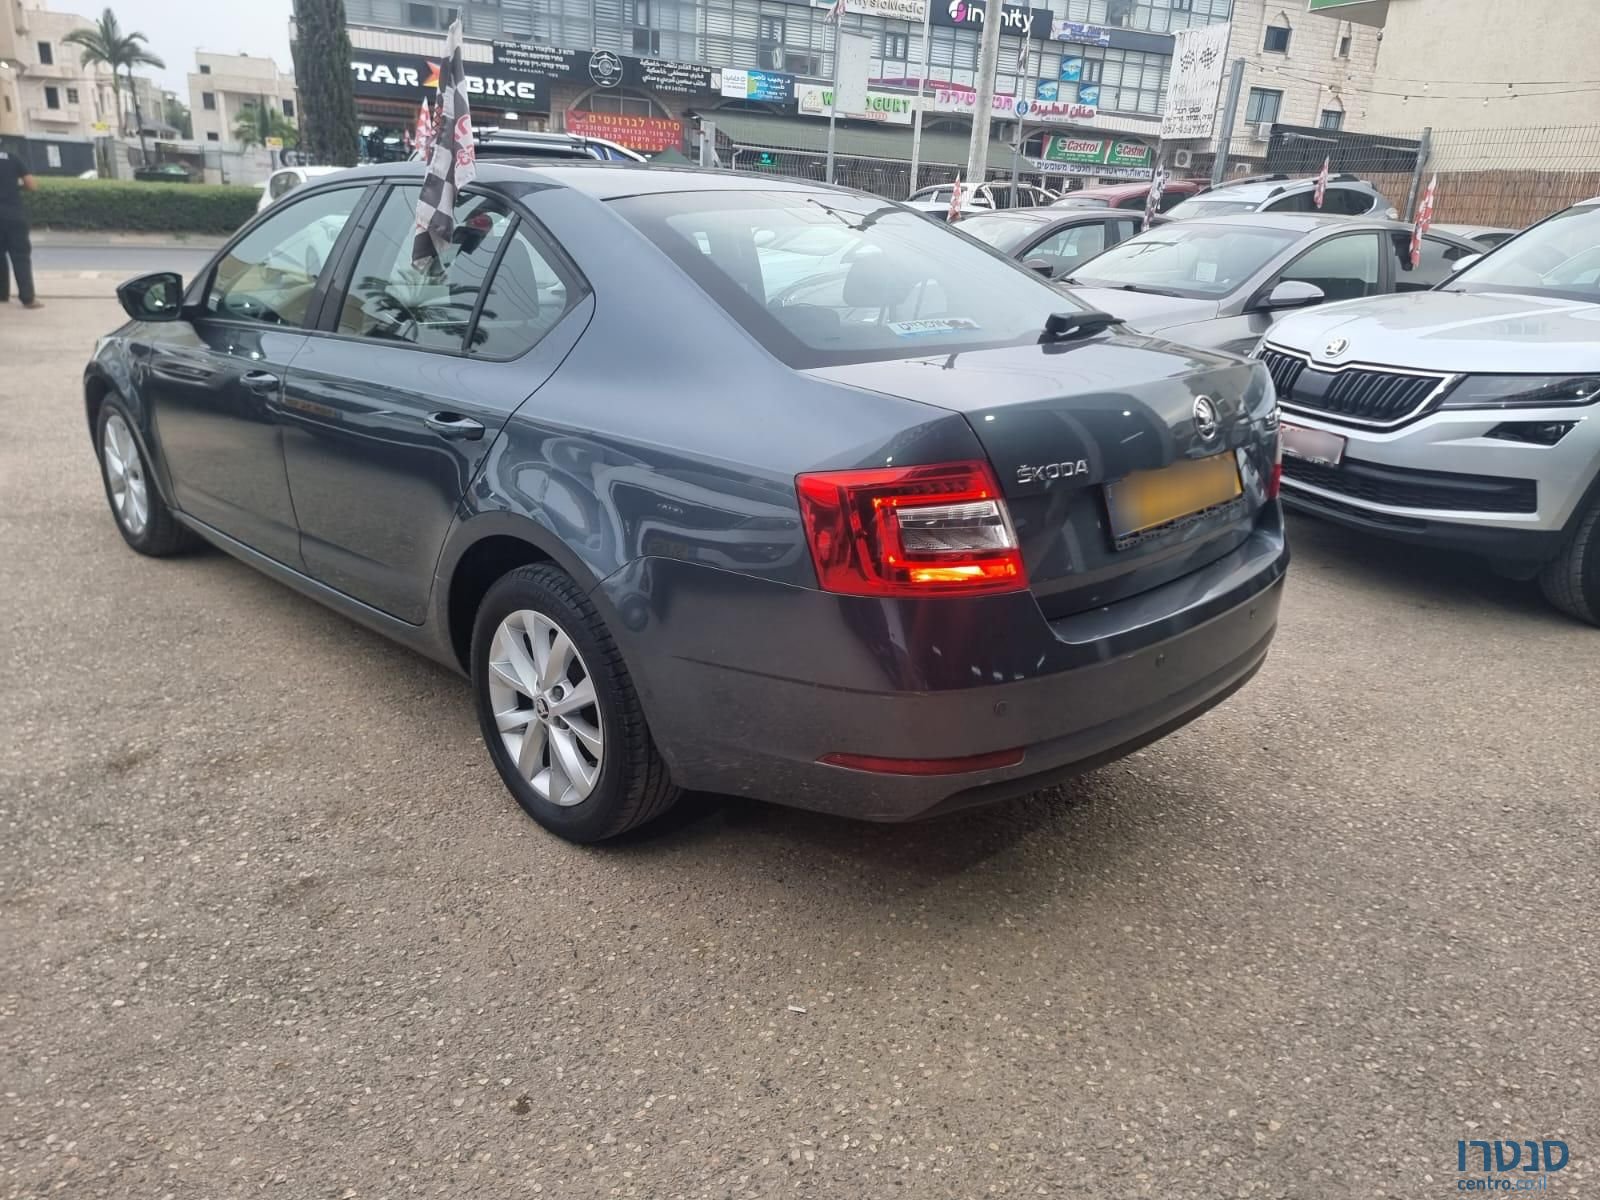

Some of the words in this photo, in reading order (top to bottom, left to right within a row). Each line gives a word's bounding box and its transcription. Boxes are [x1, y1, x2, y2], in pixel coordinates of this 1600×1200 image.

[465, 76, 536, 99] BIKE
[1067, 140, 1098, 154] Castrol
[1122, 144, 1146, 158] Castrol
[1017, 459, 1088, 484] ŠKODA
